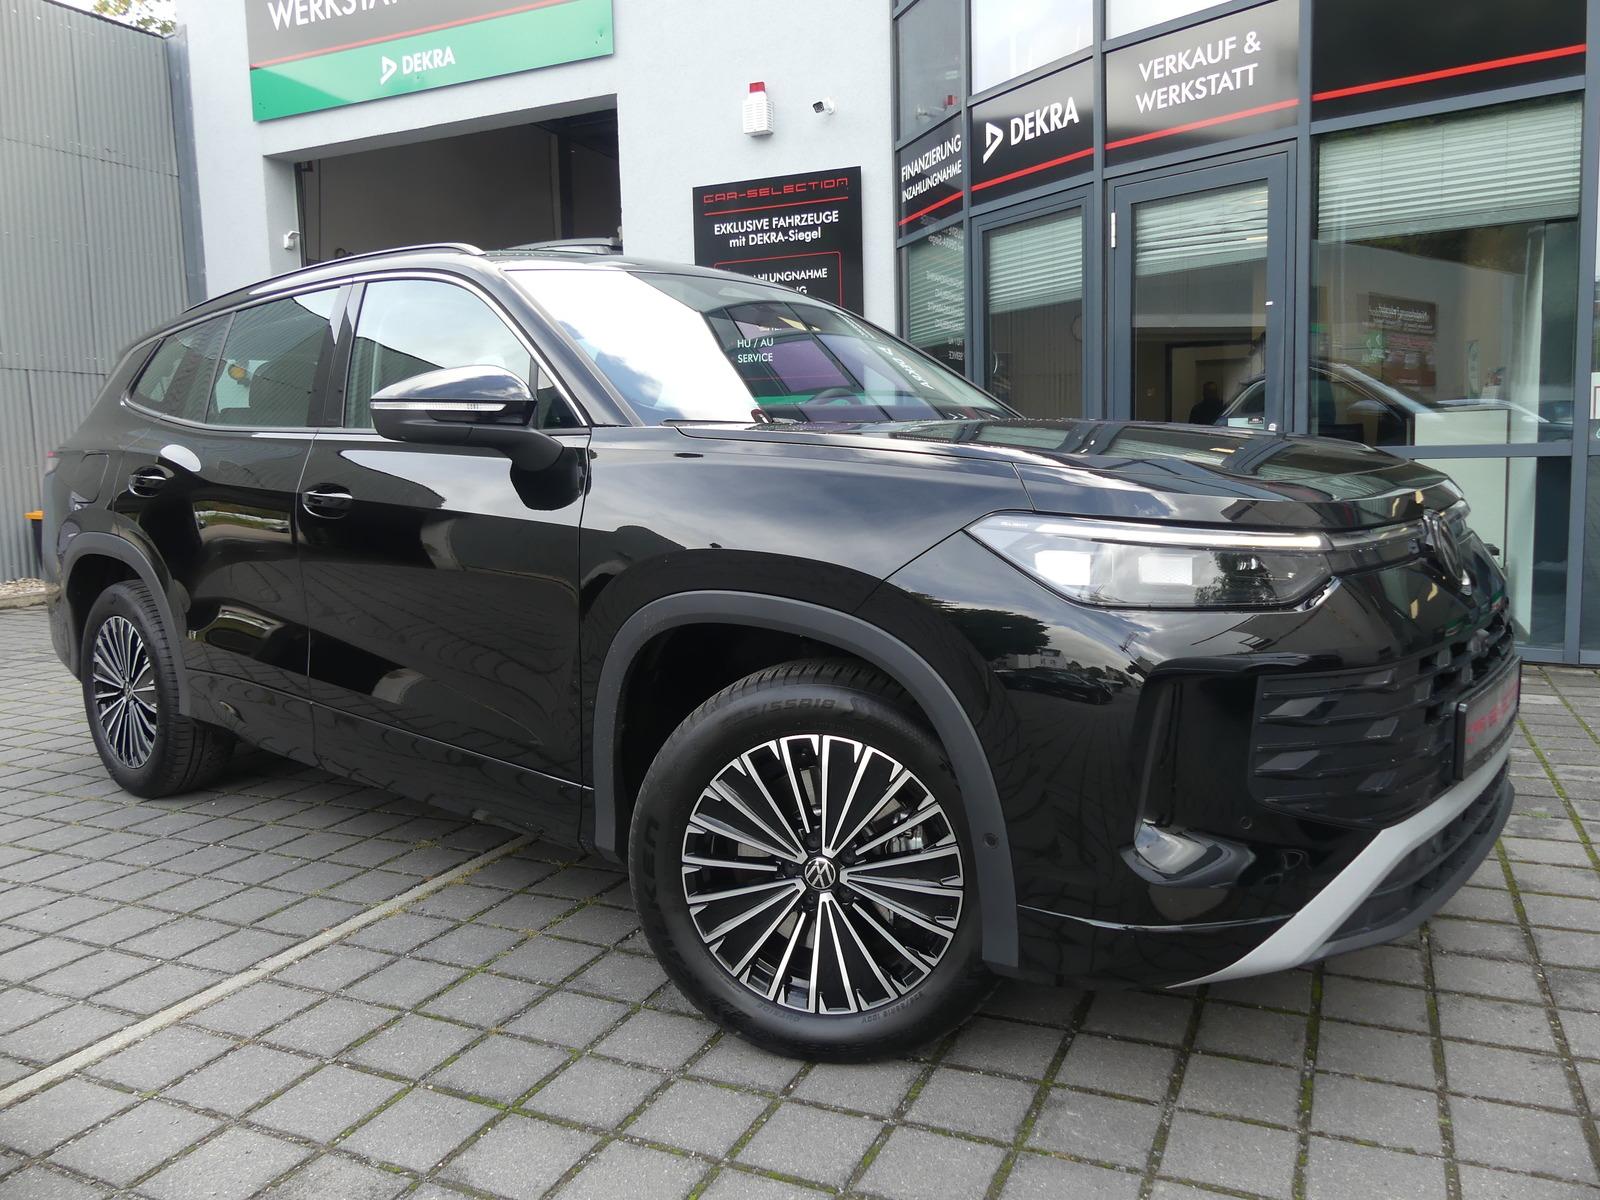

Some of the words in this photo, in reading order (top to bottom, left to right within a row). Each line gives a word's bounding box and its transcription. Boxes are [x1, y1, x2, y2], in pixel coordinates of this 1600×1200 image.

[402, 46, 457, 75] DEKRA
[1138, 36, 1237, 83] VERKAUF
[1243, 30, 1262, 54] &
[1135, 62, 1259, 114] WERKSTATT
[1010, 96, 1080, 146] DEKRA
[901, 134, 962, 183] FINANZIERUNG
[703, 177, 848, 204] CAR-SELECTION
[714, 218, 770, 236] EXKLUSIVE
[772, 210, 839, 230] FAHRZEUGE
[729, 235, 746, 248] mit
[748, 226, 822, 247] DEKRA-Siegel
[737, 339, 751, 349] HU
[760, 337, 774, 347] AU
[737, 352, 774, 364] SERVICE
